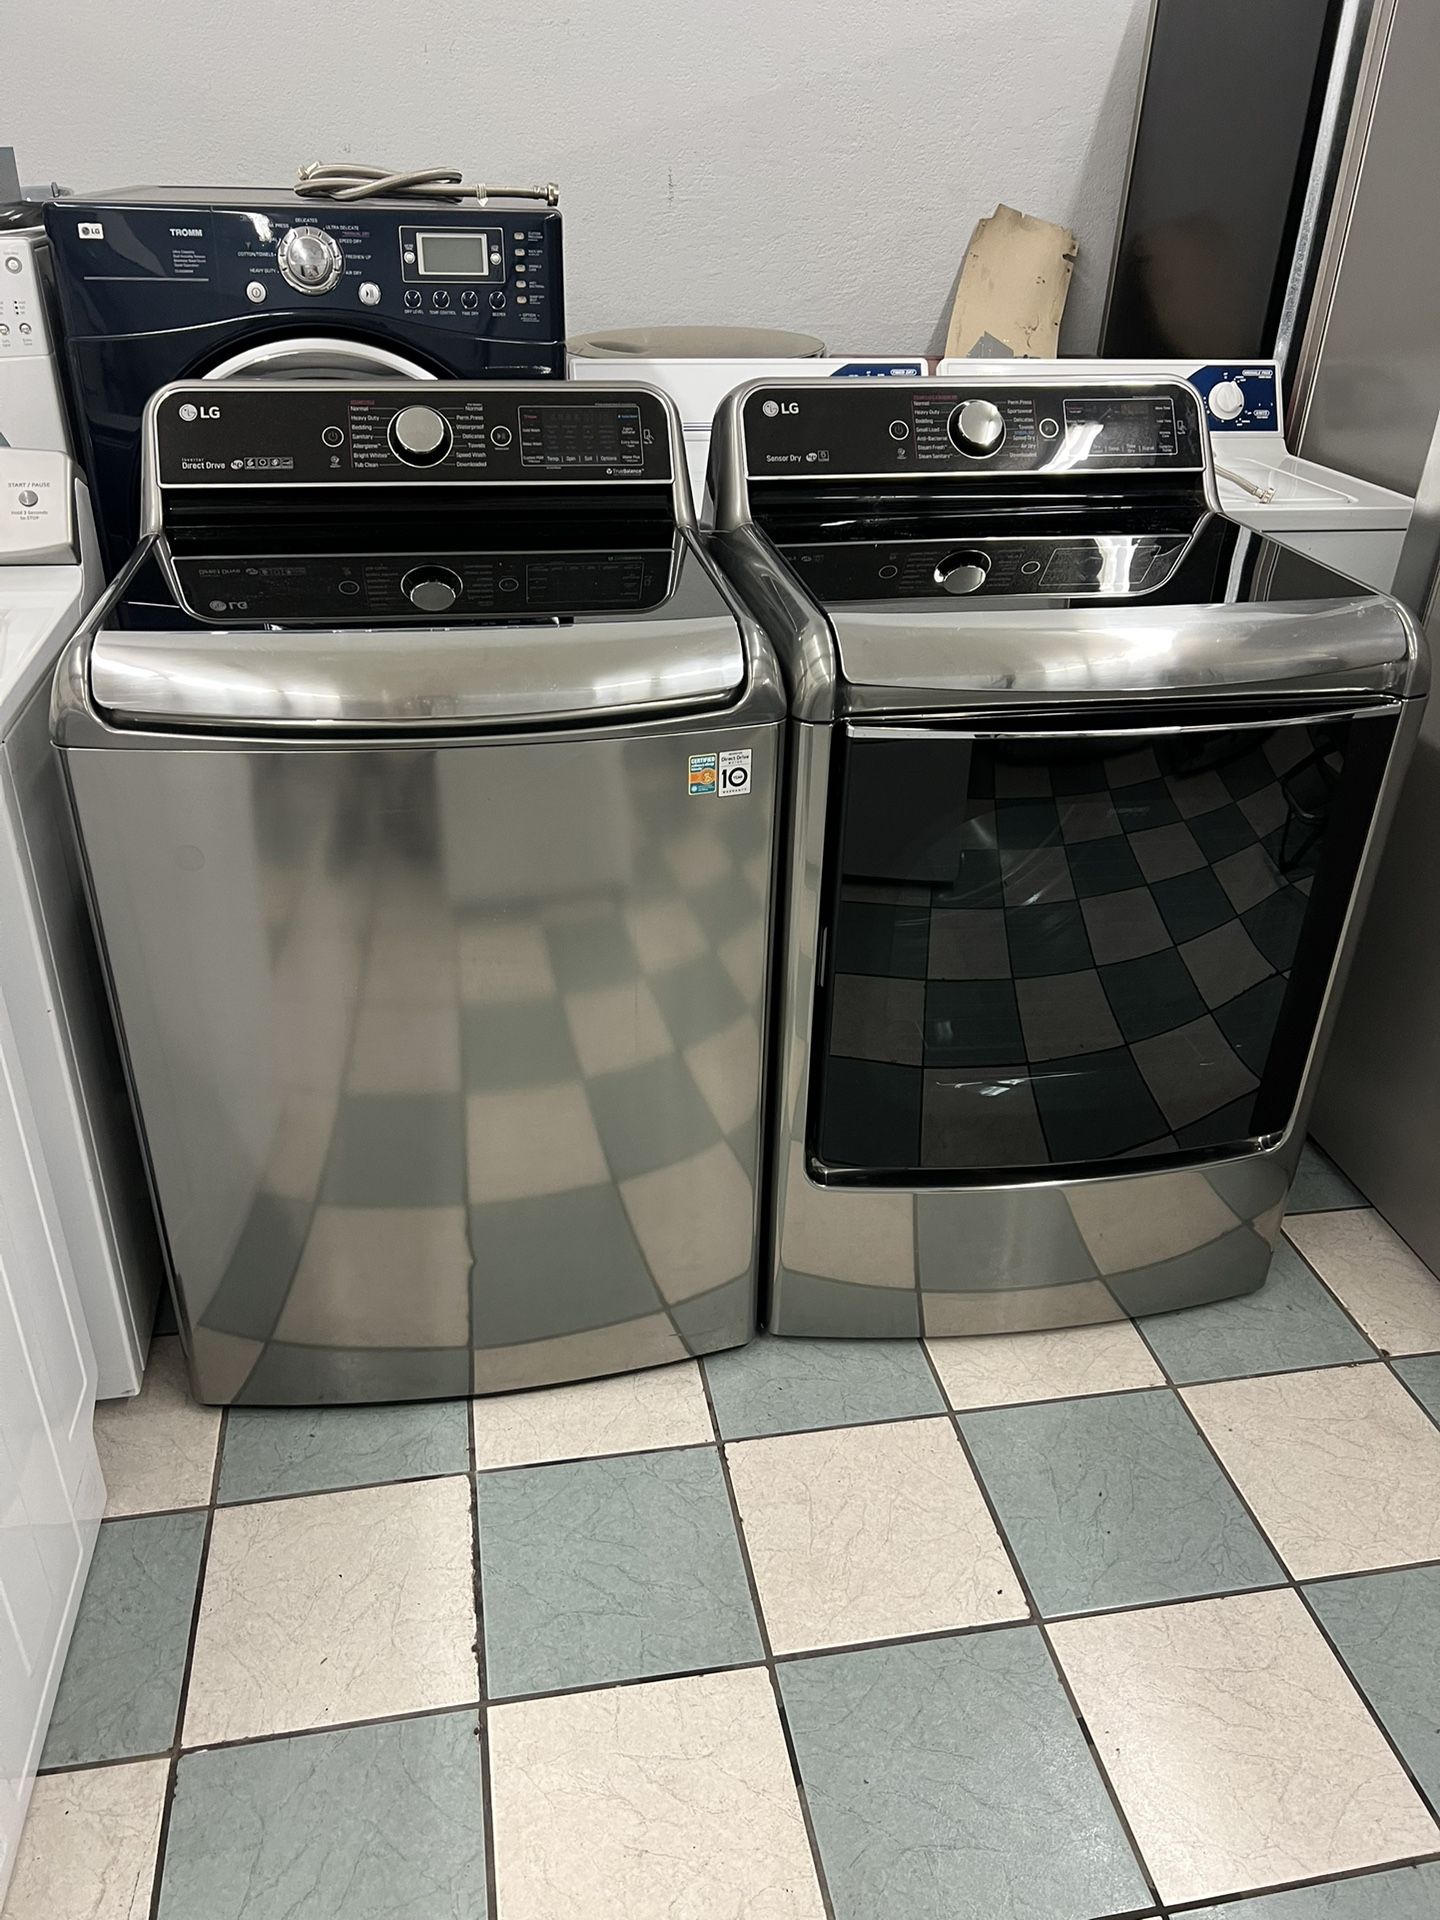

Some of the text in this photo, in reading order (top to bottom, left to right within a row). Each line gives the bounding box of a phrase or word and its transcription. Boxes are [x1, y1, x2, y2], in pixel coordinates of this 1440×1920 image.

[169, 228, 203, 237] TROMM
[200, 406, 221, 419] LG
[781, 402, 799, 415] LG
[766, 454, 802, 463] Sensor Dry
[182, 461, 226, 470] Direct Drive
[722, 767, 748, 789] 10
